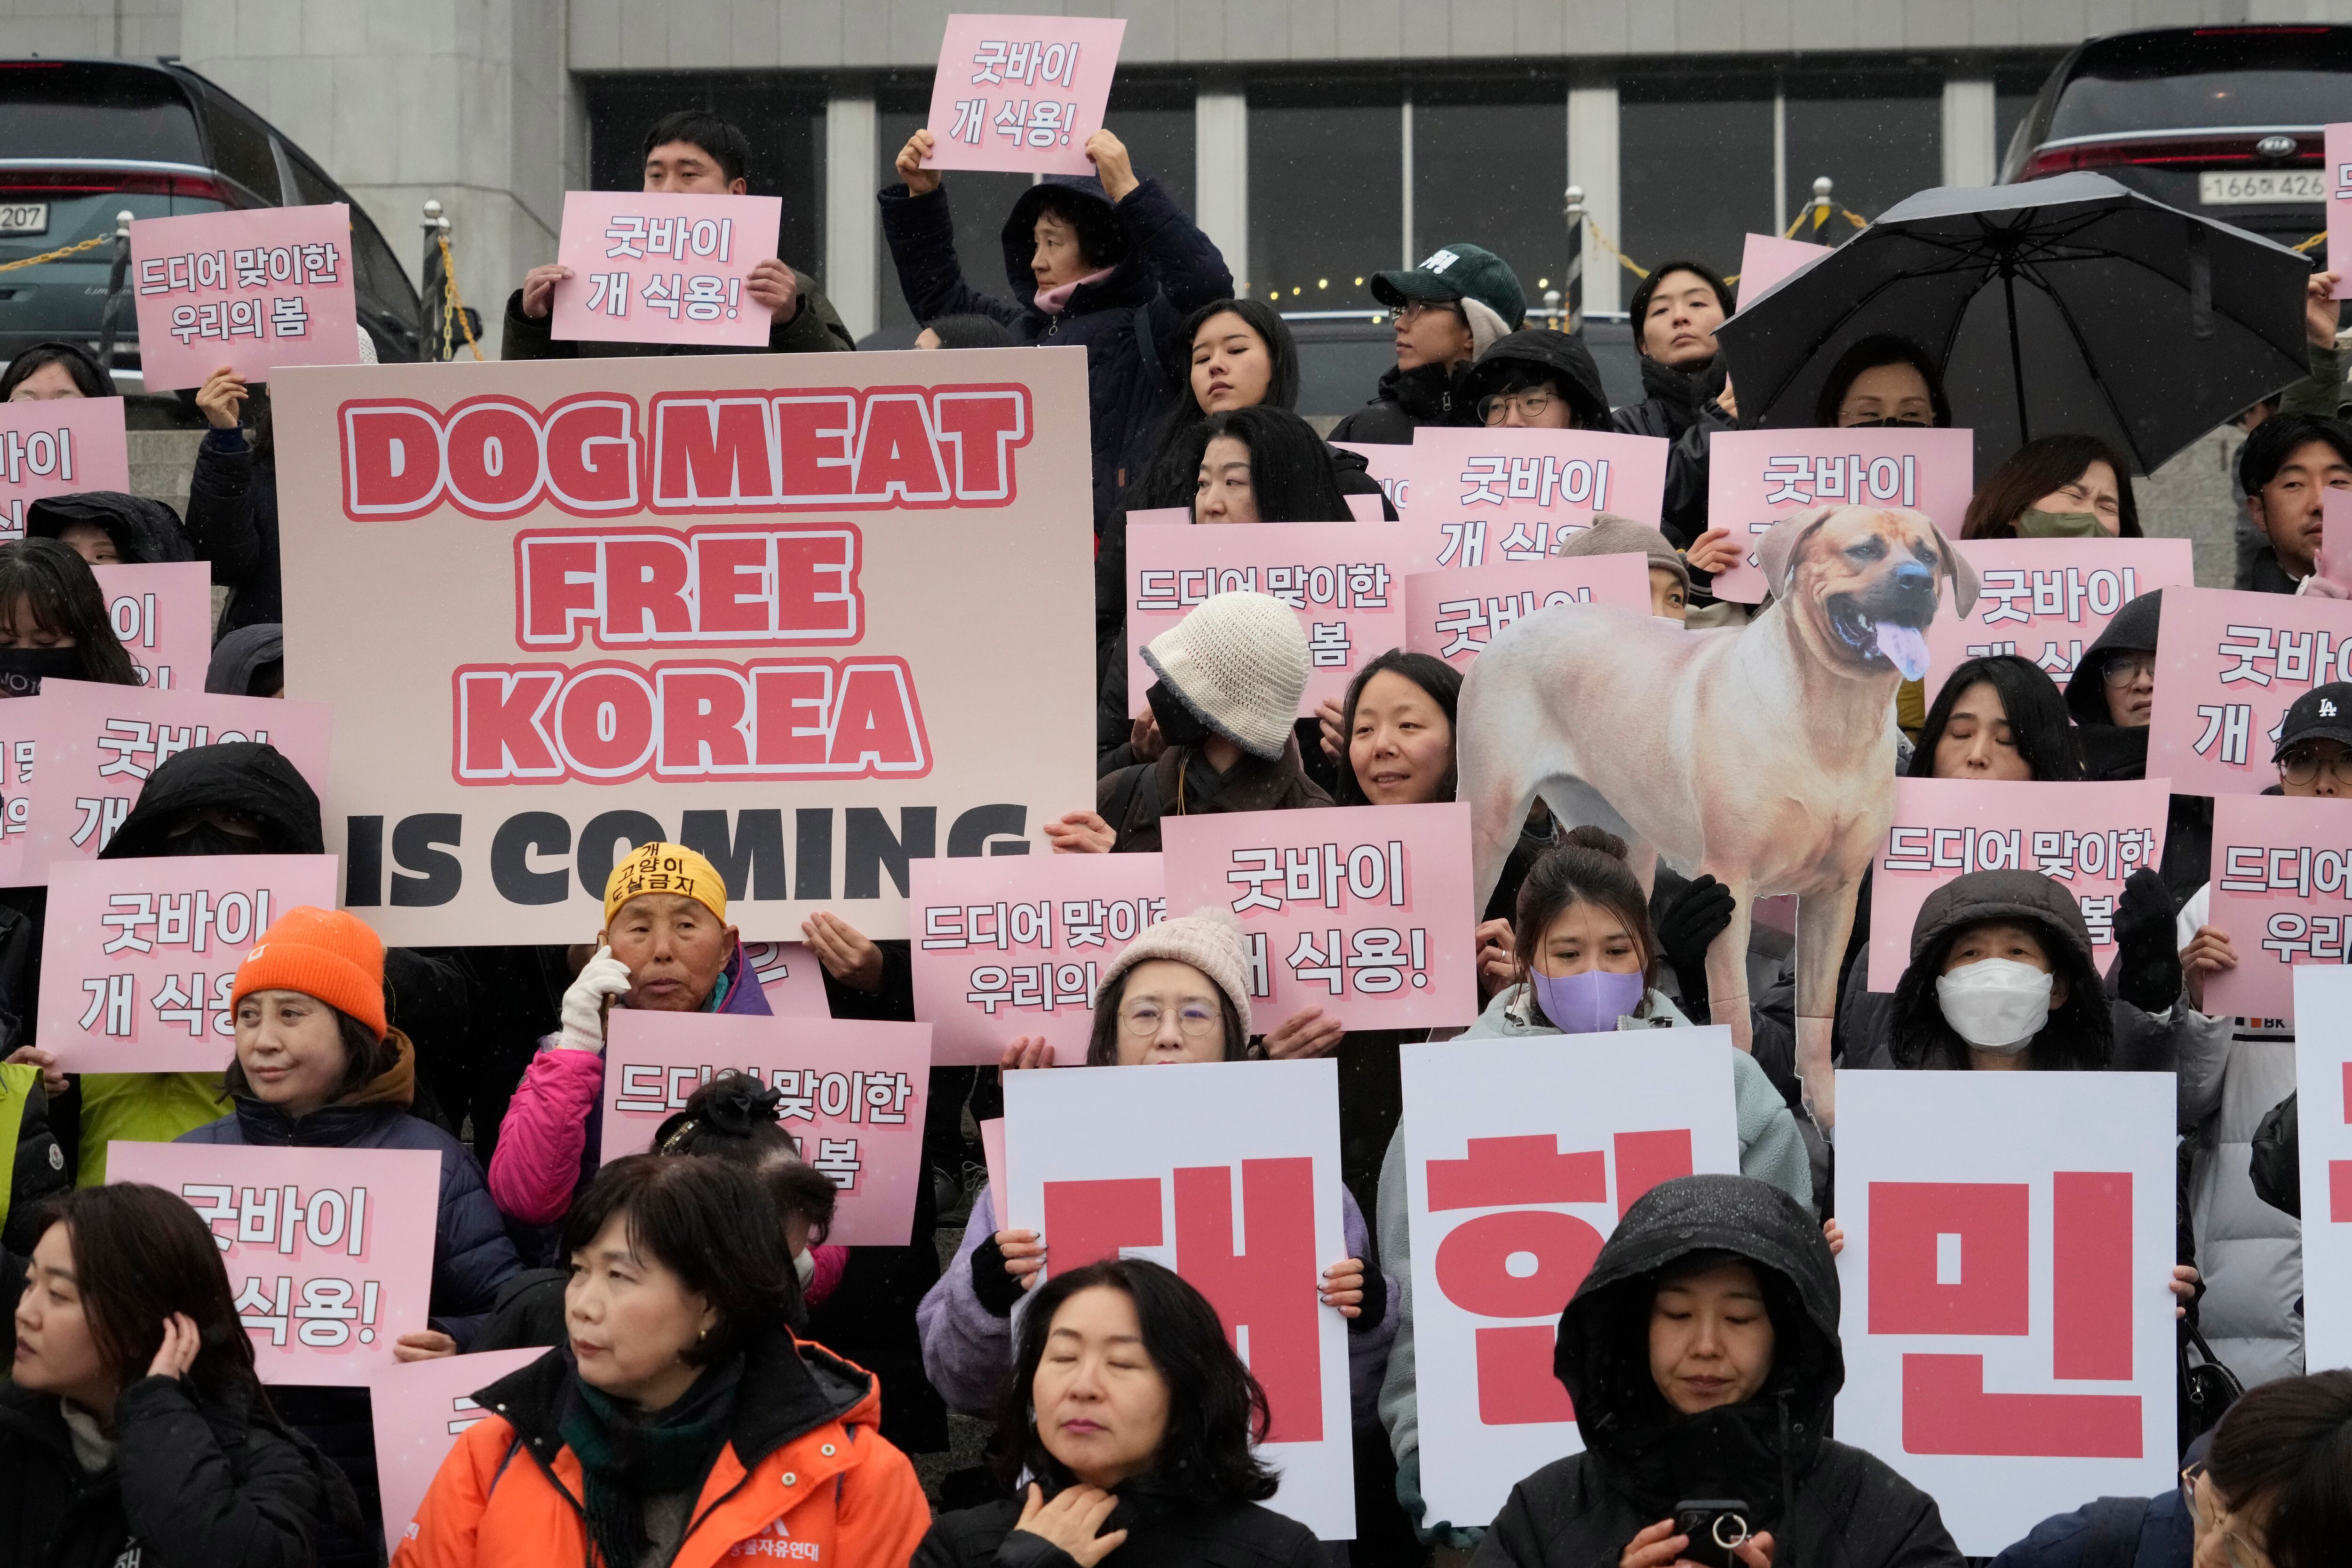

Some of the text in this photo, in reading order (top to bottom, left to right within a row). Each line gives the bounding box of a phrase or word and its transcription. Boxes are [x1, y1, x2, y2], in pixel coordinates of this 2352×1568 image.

[972, 40, 1080, 87] 굿바이
[951, 98, 1077, 147] 개 식용!
[1, 207, 40, 226] 207
[606, 216, 731, 262] 굿바이
[141, 244, 338, 294] 드디어 맞이한
[172, 296, 308, 344] 우리의 봄
[588, 272, 740, 320] 개 식용!
[337, 382, 1034, 522] DOG MEAT
[1461, 456, 1609, 511] 굿바이
[1764, 454, 1915, 507] 굿바이
[514, 522, 865, 652] FREE
[1267, 563, 1391, 610] 맞이한
[1310, 622, 1351, 667] 봄
[452, 655, 932, 787] KOREA
[2319, 699, 2336, 717] LA
[2195, 704, 2251, 764] 개
[344, 813, 462, 907] IS
[618, 858, 683, 883] 고양이
[641, 843, 659, 857] 개
[1885, 827, 2021, 876] 드디어
[612, 874, 694, 902] 도살금지
[1228, 842, 1404, 912] 굿바이
[103, 890, 269, 954] 굿바이
[922, 902, 1051, 949] 드디어
[1288, 929, 1427, 994] 식용!
[80, 975, 134, 1036] 개
[968, 962, 1097, 1013] 우리의
[772, 1070, 912, 1123] 맞이한
[234, 1277, 379, 1346] 식용!
[1868, 1171, 2143, 1458] 민
